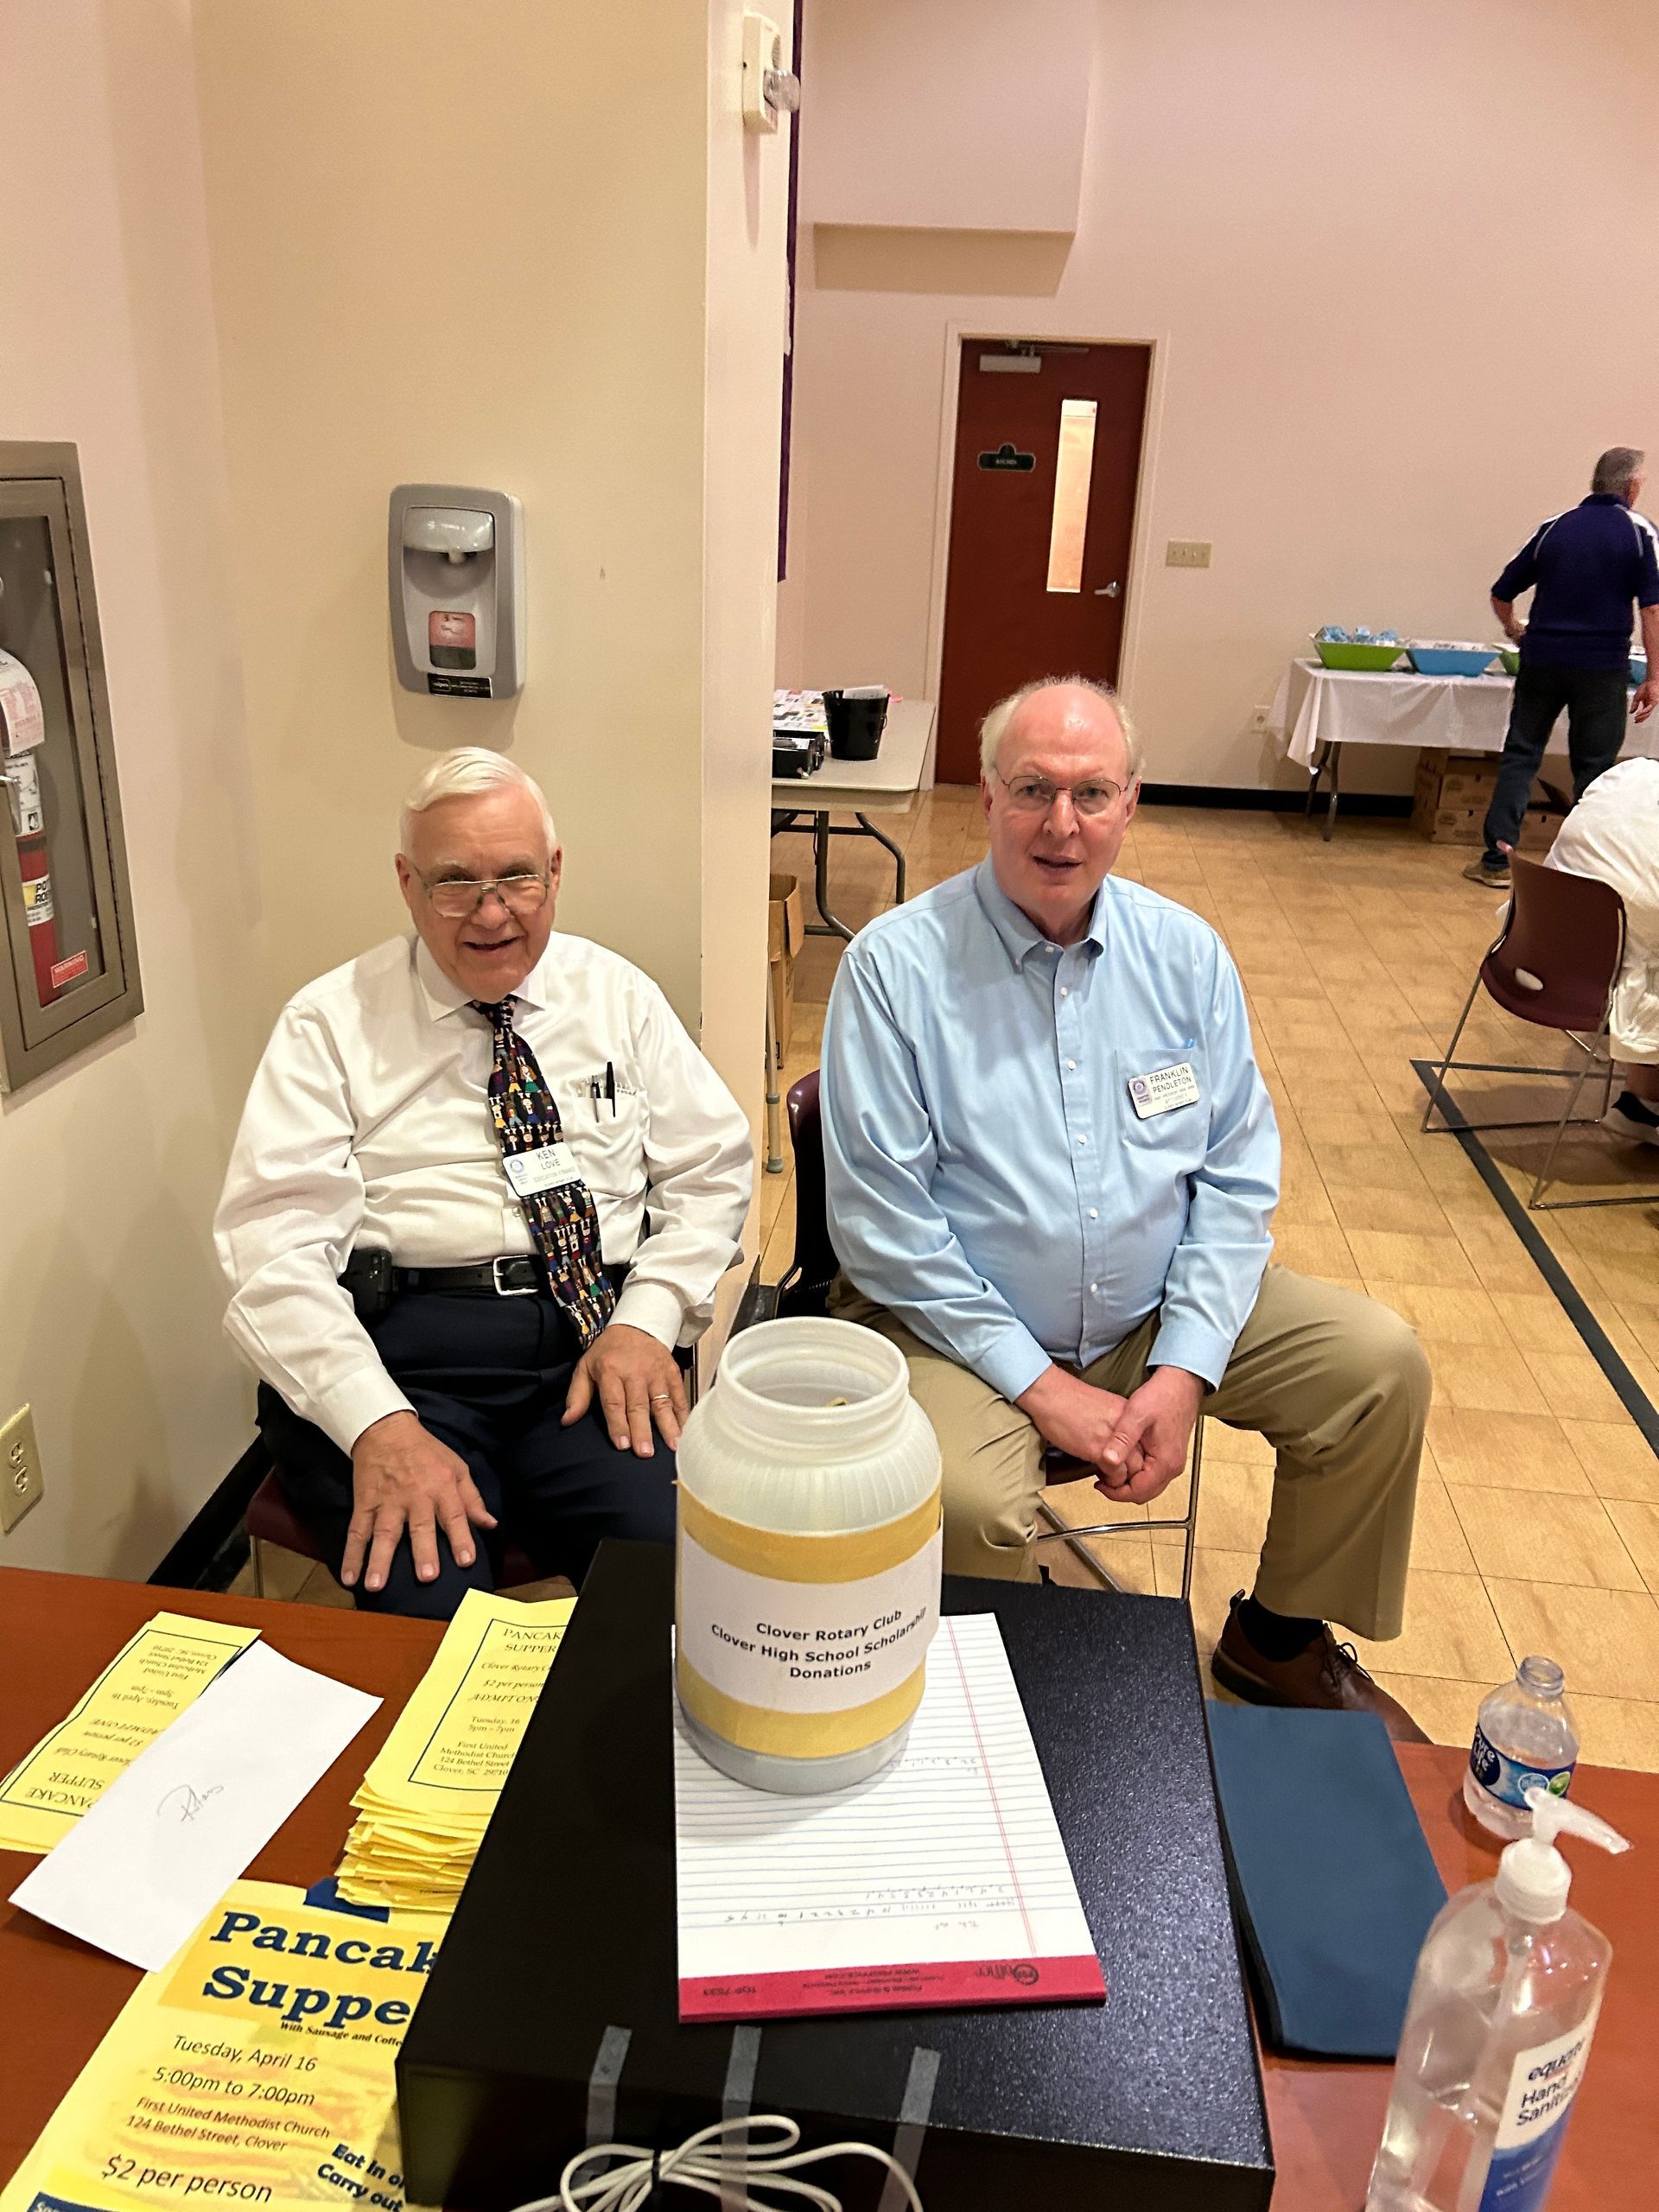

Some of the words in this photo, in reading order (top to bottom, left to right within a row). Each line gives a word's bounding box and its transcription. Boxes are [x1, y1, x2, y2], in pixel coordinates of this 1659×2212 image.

[1149, 1066, 1189, 1084] FRANKLIN
[1153, 1076, 1192, 1094] PENDLETON
[536, 1148, 556, 1160] KEN
[541, 1159, 561, 1170] LOVE
[503, 1628, 563, 1640] PANCAK
[756, 1622, 810, 1641] Clover
[816, 1624, 868, 1642] Rotary
[874, 1610, 902, 1630] Club
[505, 1643, 557, 1653] SUPPER
[711, 1624, 757, 1652] Clover
[761, 1645, 799, 1662] High
[804, 1646, 859, 1662] School
[481, 1662, 509, 1670] Clover
[790, 1660, 872, 1679] Donations
[122, 1694, 144, 1704] April
[479, 1742, 509, 1751] United
[48, 1772, 105, 1790] SUPPER
[209, 1910, 438, 1974] Pancak
[202, 1965, 411, 2030] Suppe
[280, 2021, 303, 2033] With
[306, 2025, 349, 2040] Sausage
[352, 2032, 372, 2043] and
[374, 2035, 404, 2047] Coffe
[172, 2035, 245, 2063] Tuesday,
[247, 2049, 293, 2069] April
[294, 2056, 319, 2072] 16
[152, 2066, 220, 2092] 5:00pm
[225, 2081, 244, 2096] to
[247, 2083, 316, 2107] 7:00pm
[1521, 2074, 1567, 2108] Hand
[136, 2096, 166, 2112] First
[167, 2102, 213, 2121] United
[213, 2110, 281, 2132] Methodist
[283, 2120, 331, 2139] Church
[126, 2115, 149, 2131] 124
[153, 2120, 198, 2139] Bethel
[198, 2128, 241, 2146] Street,
[245, 2135, 289, 2152] Clover
[332, 2143, 365, 2169] Eat
[366, 2160, 386, 2179] In
[102, 2153, 137, 2182] $2
[137, 2167, 184, 2189] per
[184, 2173, 274, 2203] person
[317, 2164, 370, 2198] Carry
[370, 2192, 403, 2212] out
